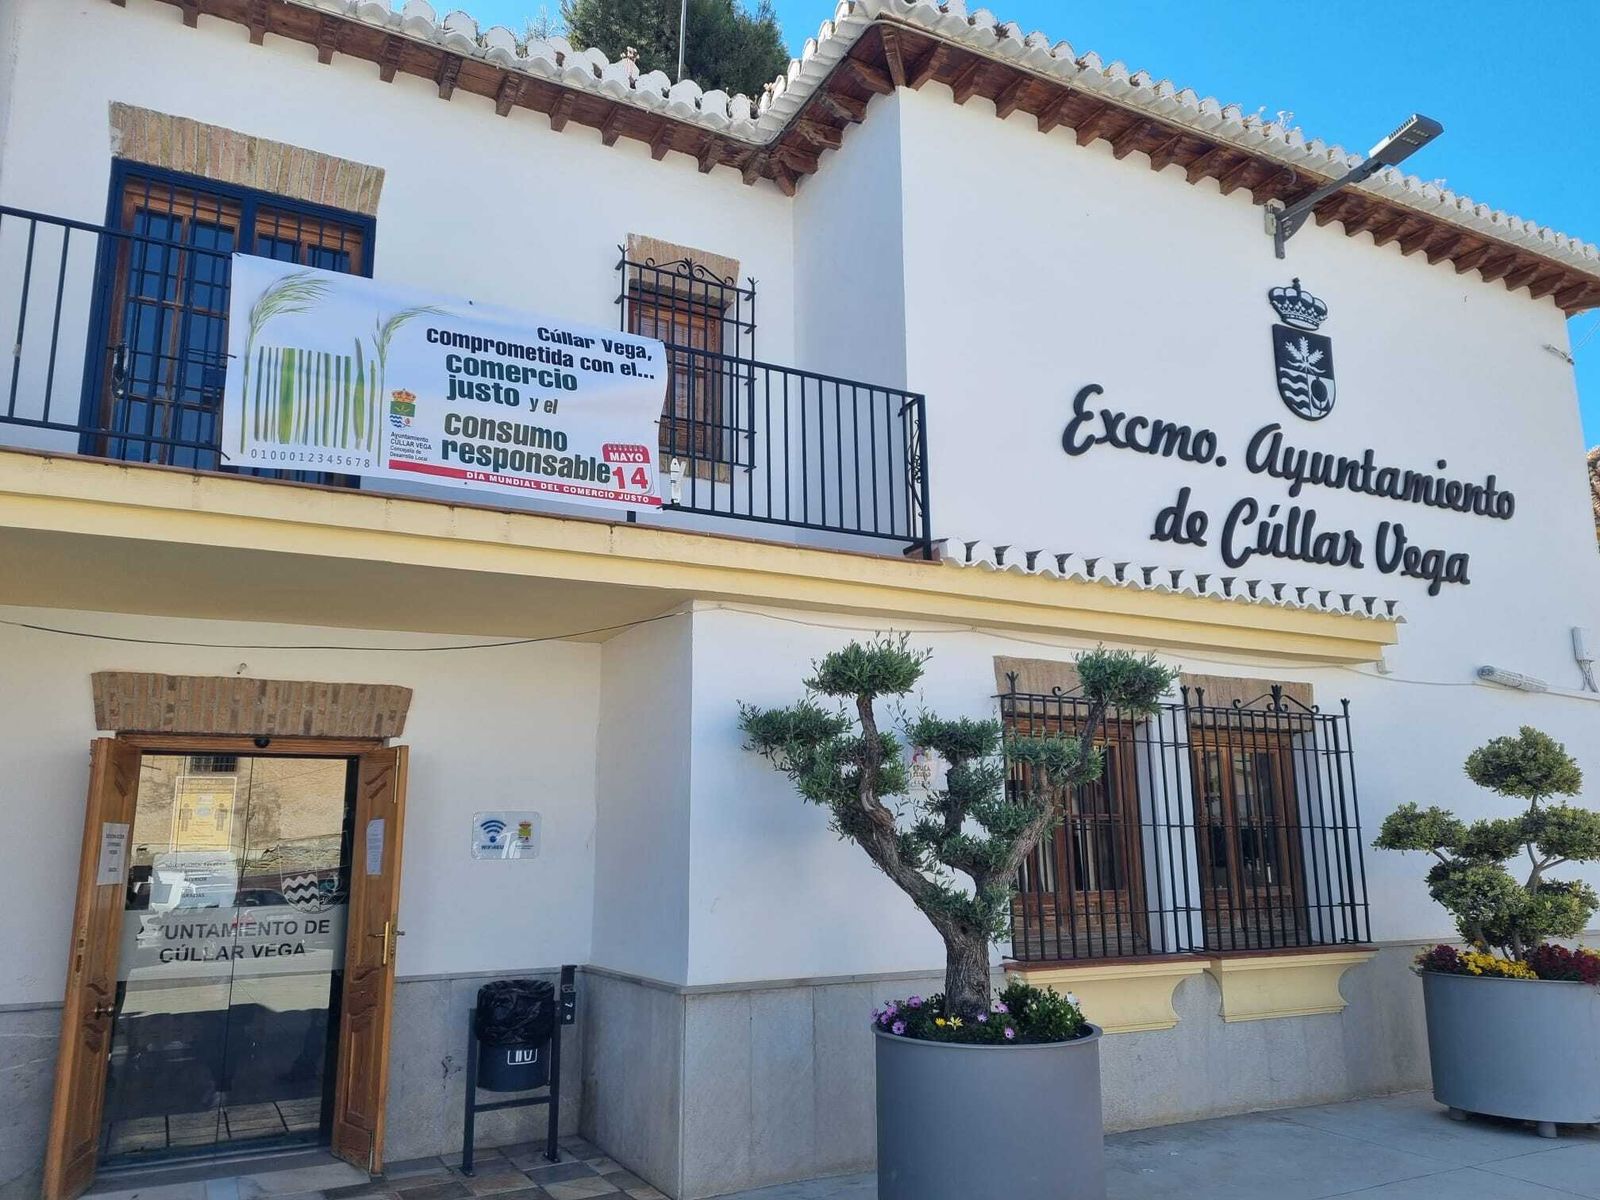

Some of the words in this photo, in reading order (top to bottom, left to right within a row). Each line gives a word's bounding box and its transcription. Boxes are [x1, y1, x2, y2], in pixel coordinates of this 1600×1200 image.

[426, 327, 574, 368] comprometida
[579, 356, 614, 374] con
[620, 362, 655, 379] el...
[536, 327, 595, 349] Cúllar
[601, 338, 653, 361] Vega,
[445, 353, 578, 391] comercio
[446, 375, 520, 407] justo
[528, 397, 539, 412] y
[543, 398, 558, 414] el
[444, 412, 568, 451] consumo
[251, 449, 369, 467] 0100012345678
[441, 439, 611, 484] responsable
[609, 452, 645, 462] MAYO
[1062, 383, 1227, 467] Excmo.
[1245, 423, 1516, 520] Ayuntamiento
[466, 472, 485, 480] DÍA
[489, 474, 537, 488] MUNDIAL
[540, 483, 559, 491] DEL
[563, 486, 615, 499] COMERCIO
[618, 493, 650, 503] JUSTO
[612, 466, 649, 489] 14
[1150, 486, 1208, 547] de
[1221, 497, 1364, 569] Cúllar
[1376, 521, 1471, 596] Vega
[304, 919, 330, 934] DE
[159, 944, 244, 963] CÚLLAR
[251, 942, 306, 958] VEGA
